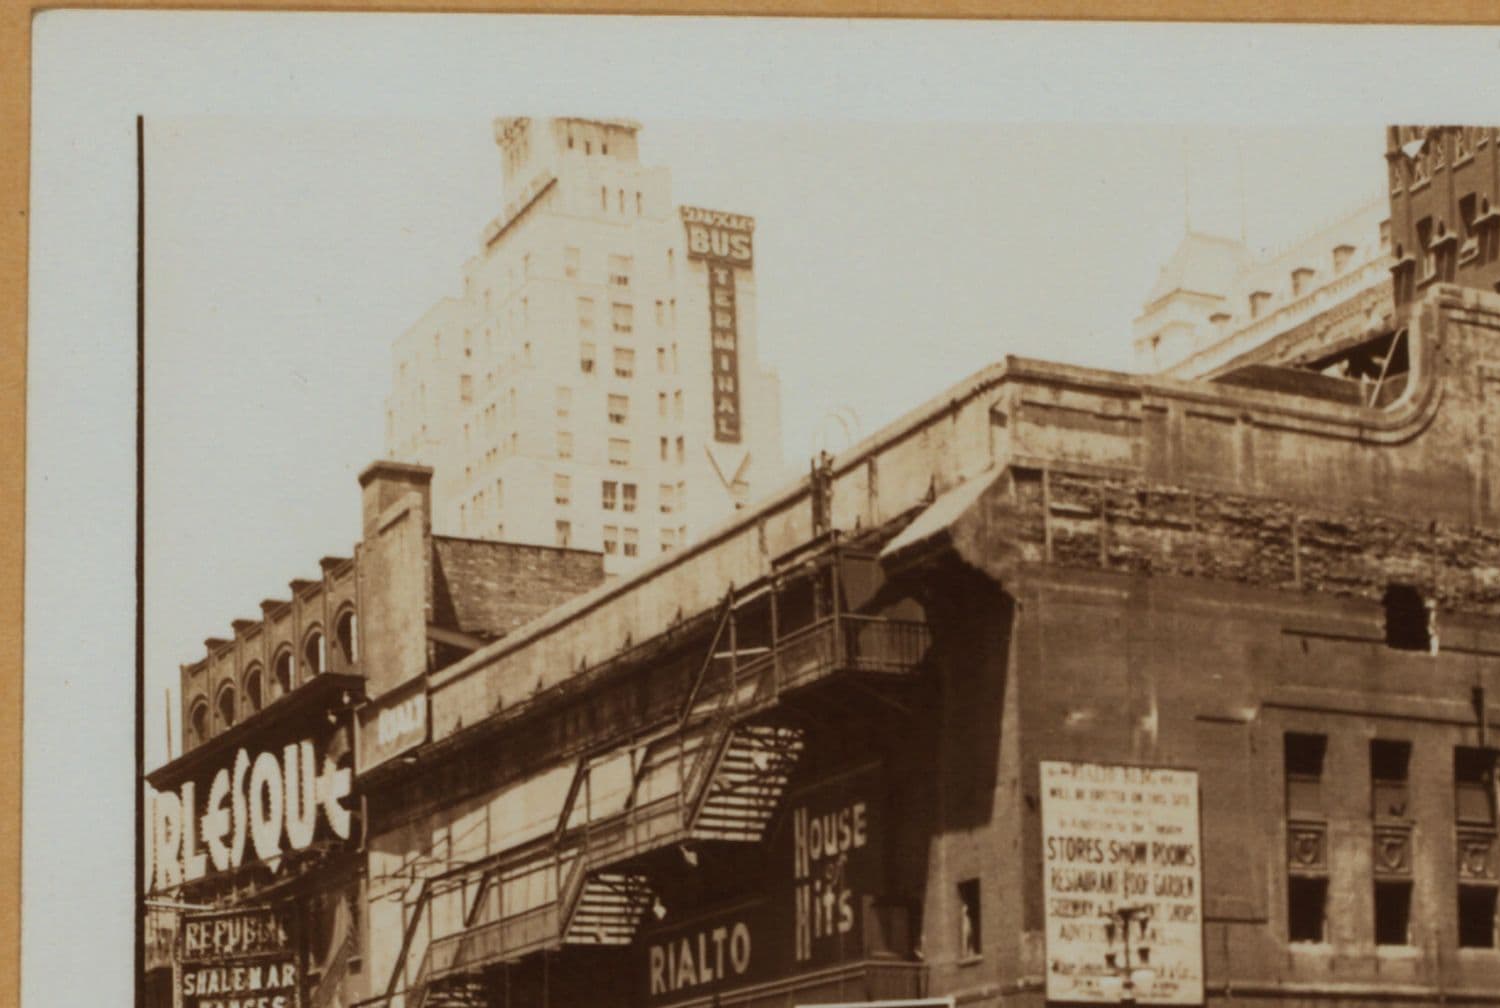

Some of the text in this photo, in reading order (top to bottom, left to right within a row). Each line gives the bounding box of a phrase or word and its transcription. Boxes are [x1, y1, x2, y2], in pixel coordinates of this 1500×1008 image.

[690, 225, 750, 260] BUS
[713, 268, 738, 435] TERMINAL
[795, 803, 866, 879] HOUSE
[1047, 835, 1196, 867] STORES SHOW ROOMS
[651, 921, 751, 995] RIALTO
